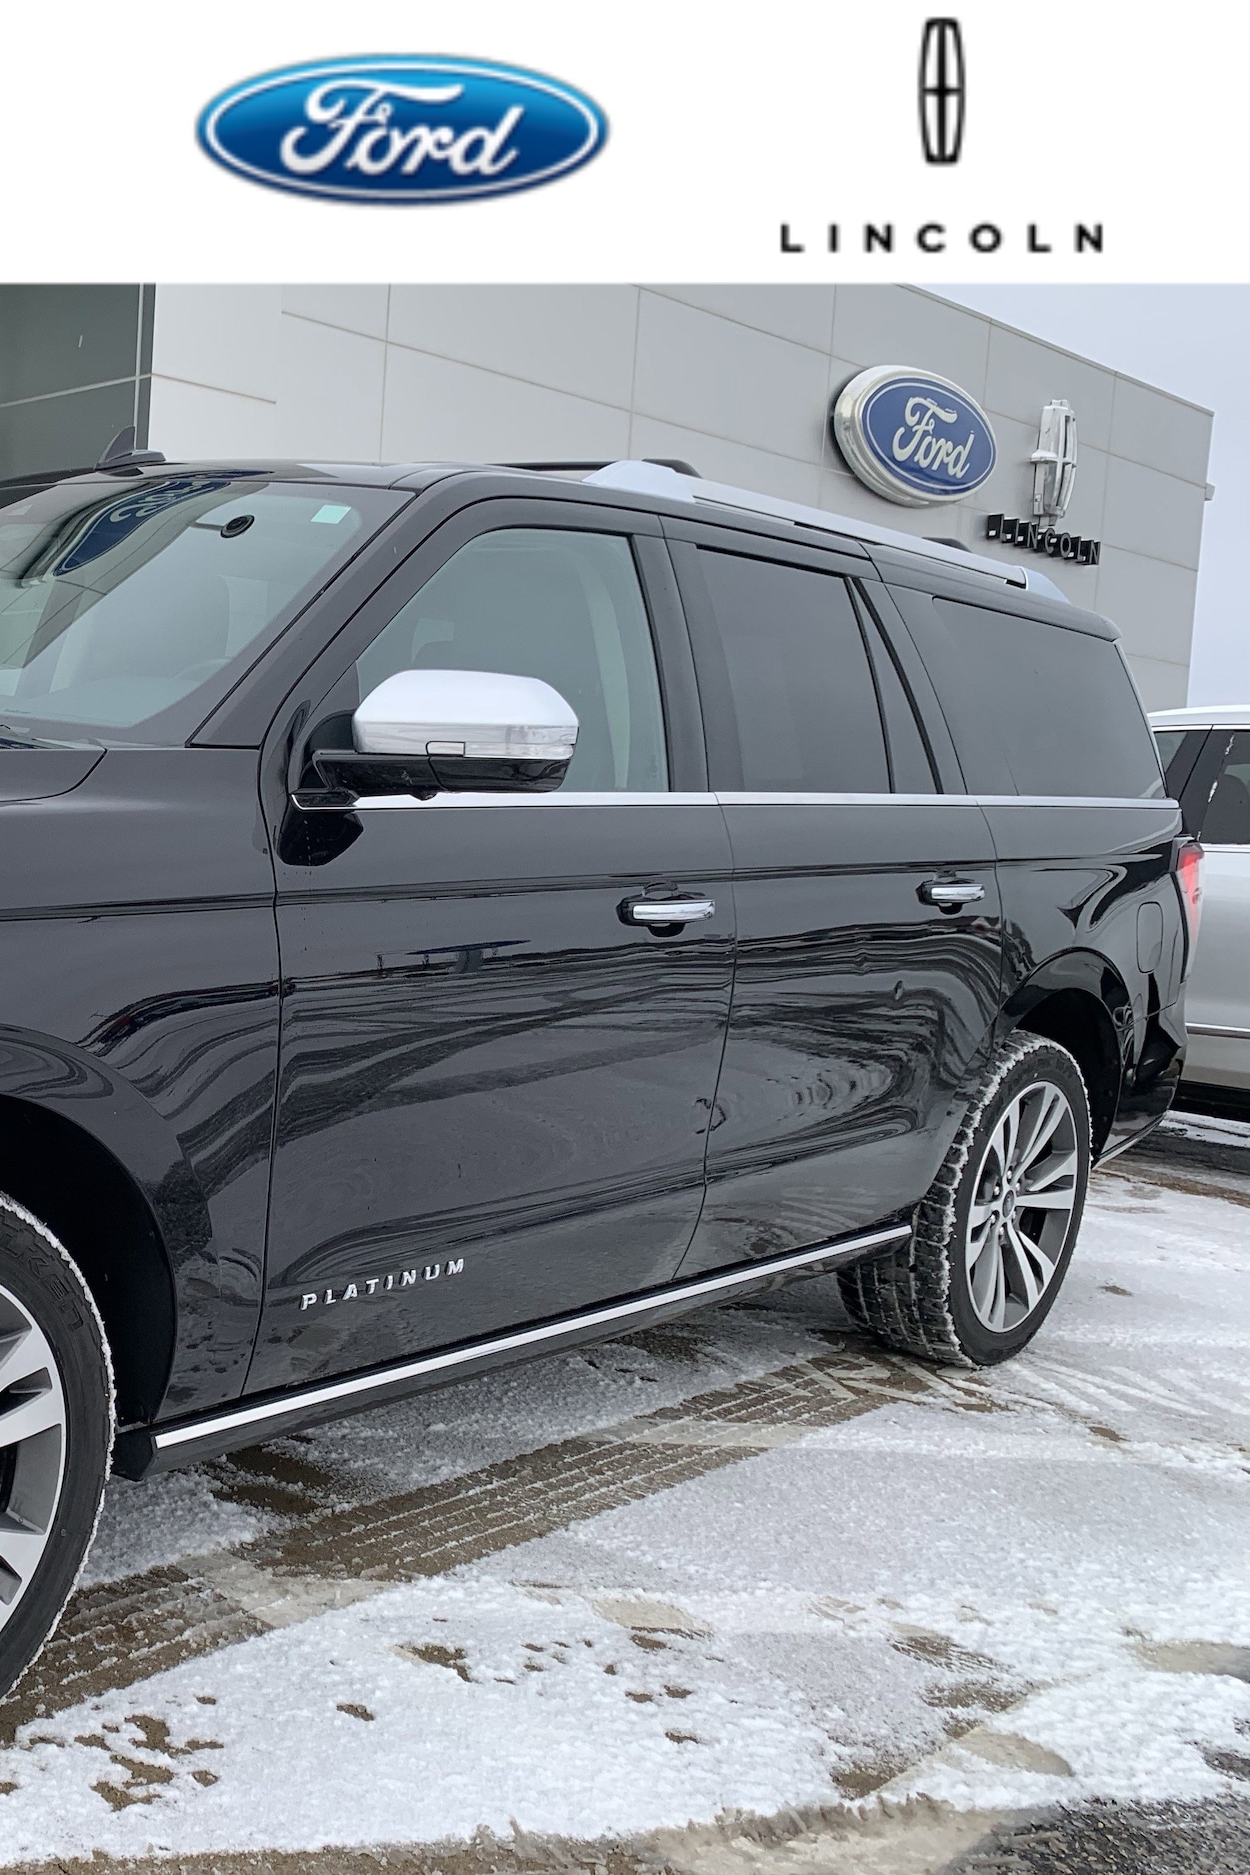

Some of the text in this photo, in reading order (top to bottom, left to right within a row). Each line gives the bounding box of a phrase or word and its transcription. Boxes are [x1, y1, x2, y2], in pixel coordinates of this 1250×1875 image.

[892, 396, 975, 479] Ford
[987, 513, 1101, 565] LINCOLN
[300, 1258, 464, 1311] PLATINUM
